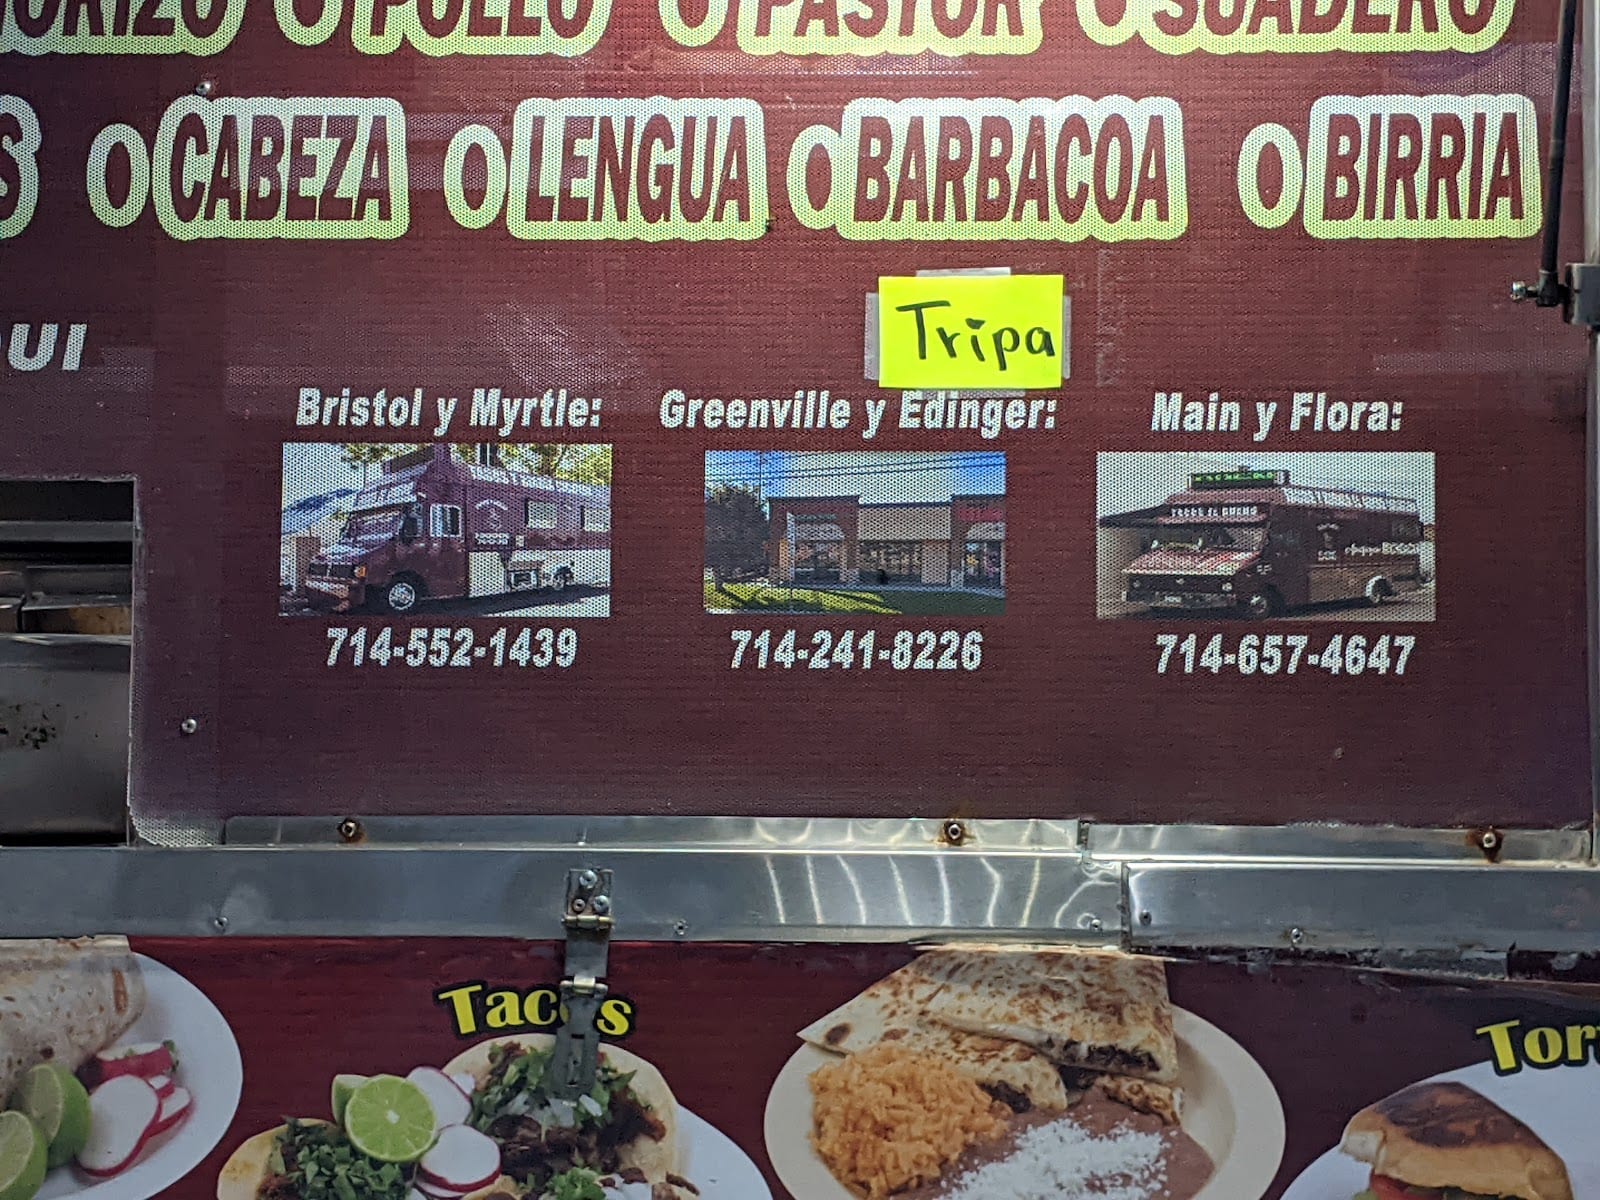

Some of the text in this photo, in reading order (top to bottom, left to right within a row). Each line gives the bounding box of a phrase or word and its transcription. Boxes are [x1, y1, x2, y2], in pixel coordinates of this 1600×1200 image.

[165, 108, 397, 227] CABEZA
[519, 109, 754, 229] LENGUA
[848, 107, 1175, 229] BARBACOA
[1317, 107, 1530, 226] BIRRIA
[1, 323, 87, 371] UI
[896, 300, 1056, 371] Tripa
[296, 387, 602, 437] Bristol y Myrtle:
[659, 389, 1057, 440] Greenville y Edinger:
[1151, 392, 1403, 441] Main y Flora:
[326, 627, 578, 668] 714-552-1439
[730, 629, 984, 670] 714-241-8226
[1156, 633, 1416, 675] 714-657-4647
[438, 984, 632, 1036] Tacs
[1476, 1019, 1600, 1070] Tor
